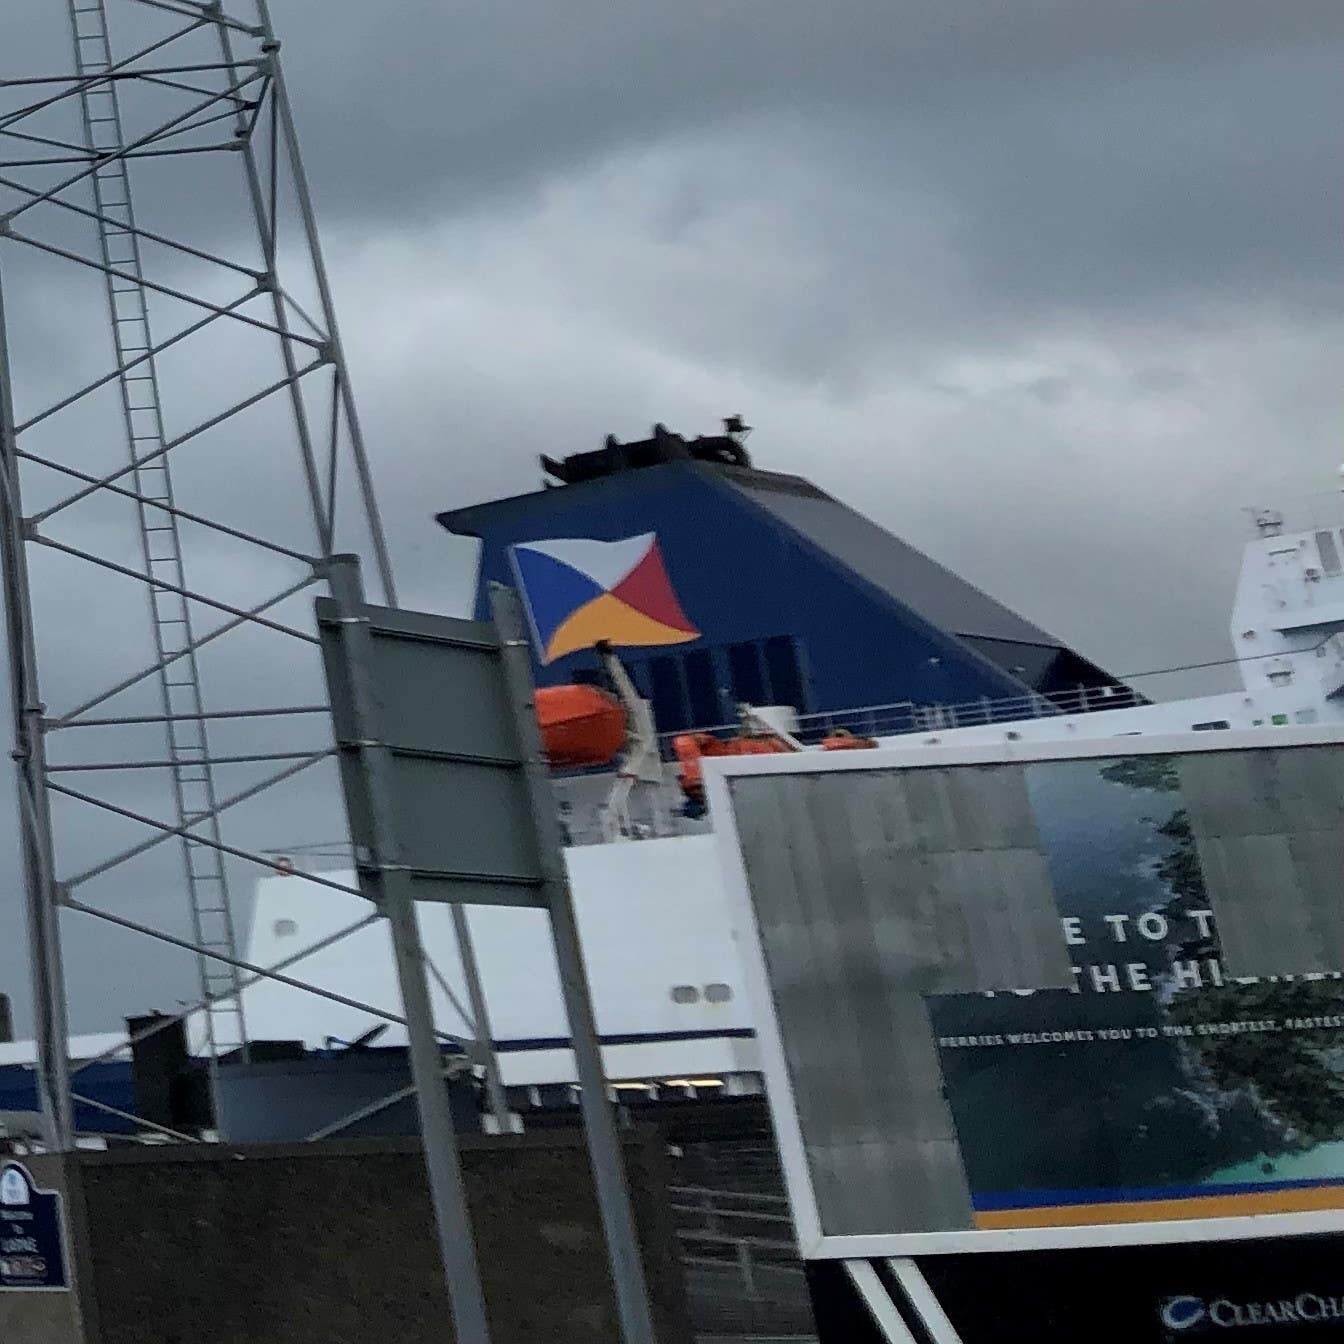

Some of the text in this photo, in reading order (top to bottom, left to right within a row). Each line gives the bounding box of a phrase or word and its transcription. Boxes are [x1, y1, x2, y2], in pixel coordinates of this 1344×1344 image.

[1104, 912, 1168, 943] TO
[1096, 1027, 1132, 1040] YOU
[1135, 1027, 1158, 1039] TO
[1162, 1025, 1194, 1037] THE
